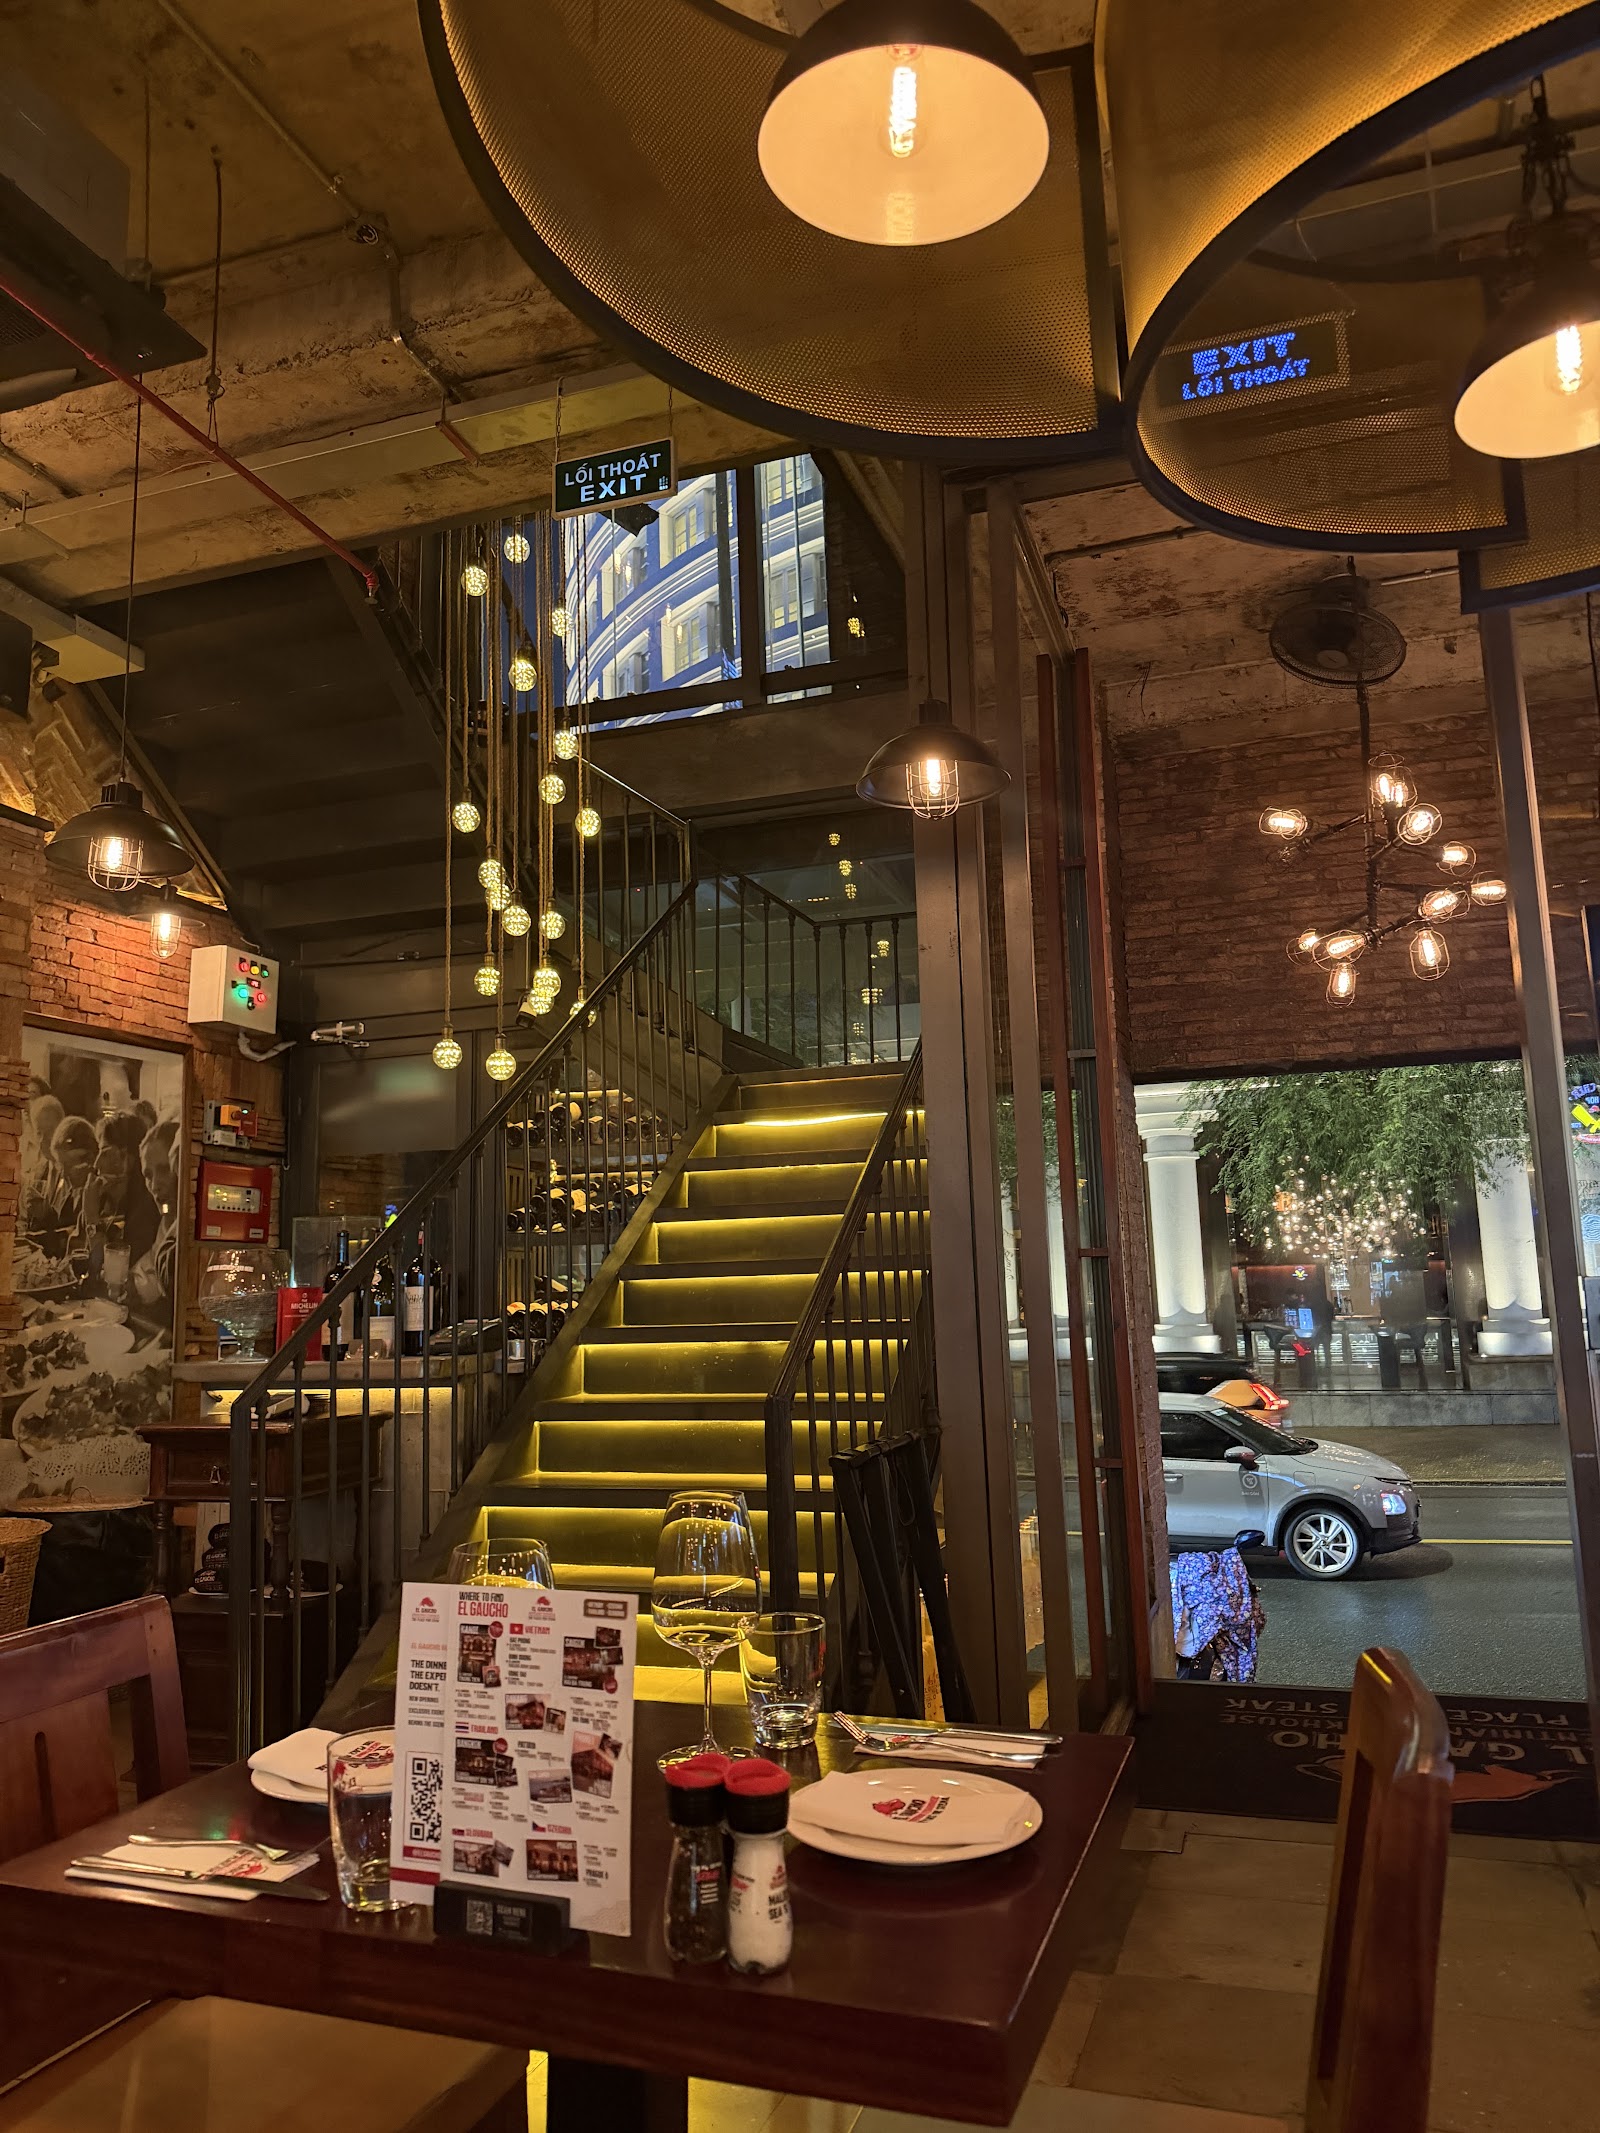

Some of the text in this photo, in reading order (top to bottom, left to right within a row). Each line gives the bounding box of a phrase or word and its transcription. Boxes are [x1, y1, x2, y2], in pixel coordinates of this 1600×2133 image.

[1192, 332, 1296, 375] EXIT
[565, 453, 661, 486] LỐI THOÁT
[580, 473, 647, 503] EXIT
[459, 1591, 504, 1602] WHERE TO FIND
[458, 1601, 509, 1618] EL GAUCHO
[525, 1625, 550, 1634] VIETNAM
[411, 1660, 424, 1668] THE
[410, 1671, 424, 1679] THE
[1224, 1698, 1338, 1714] STEAK
[1218, 1713, 1344, 1730] KHOUSE
[1446, 1709, 1569, 1727] PLACE
